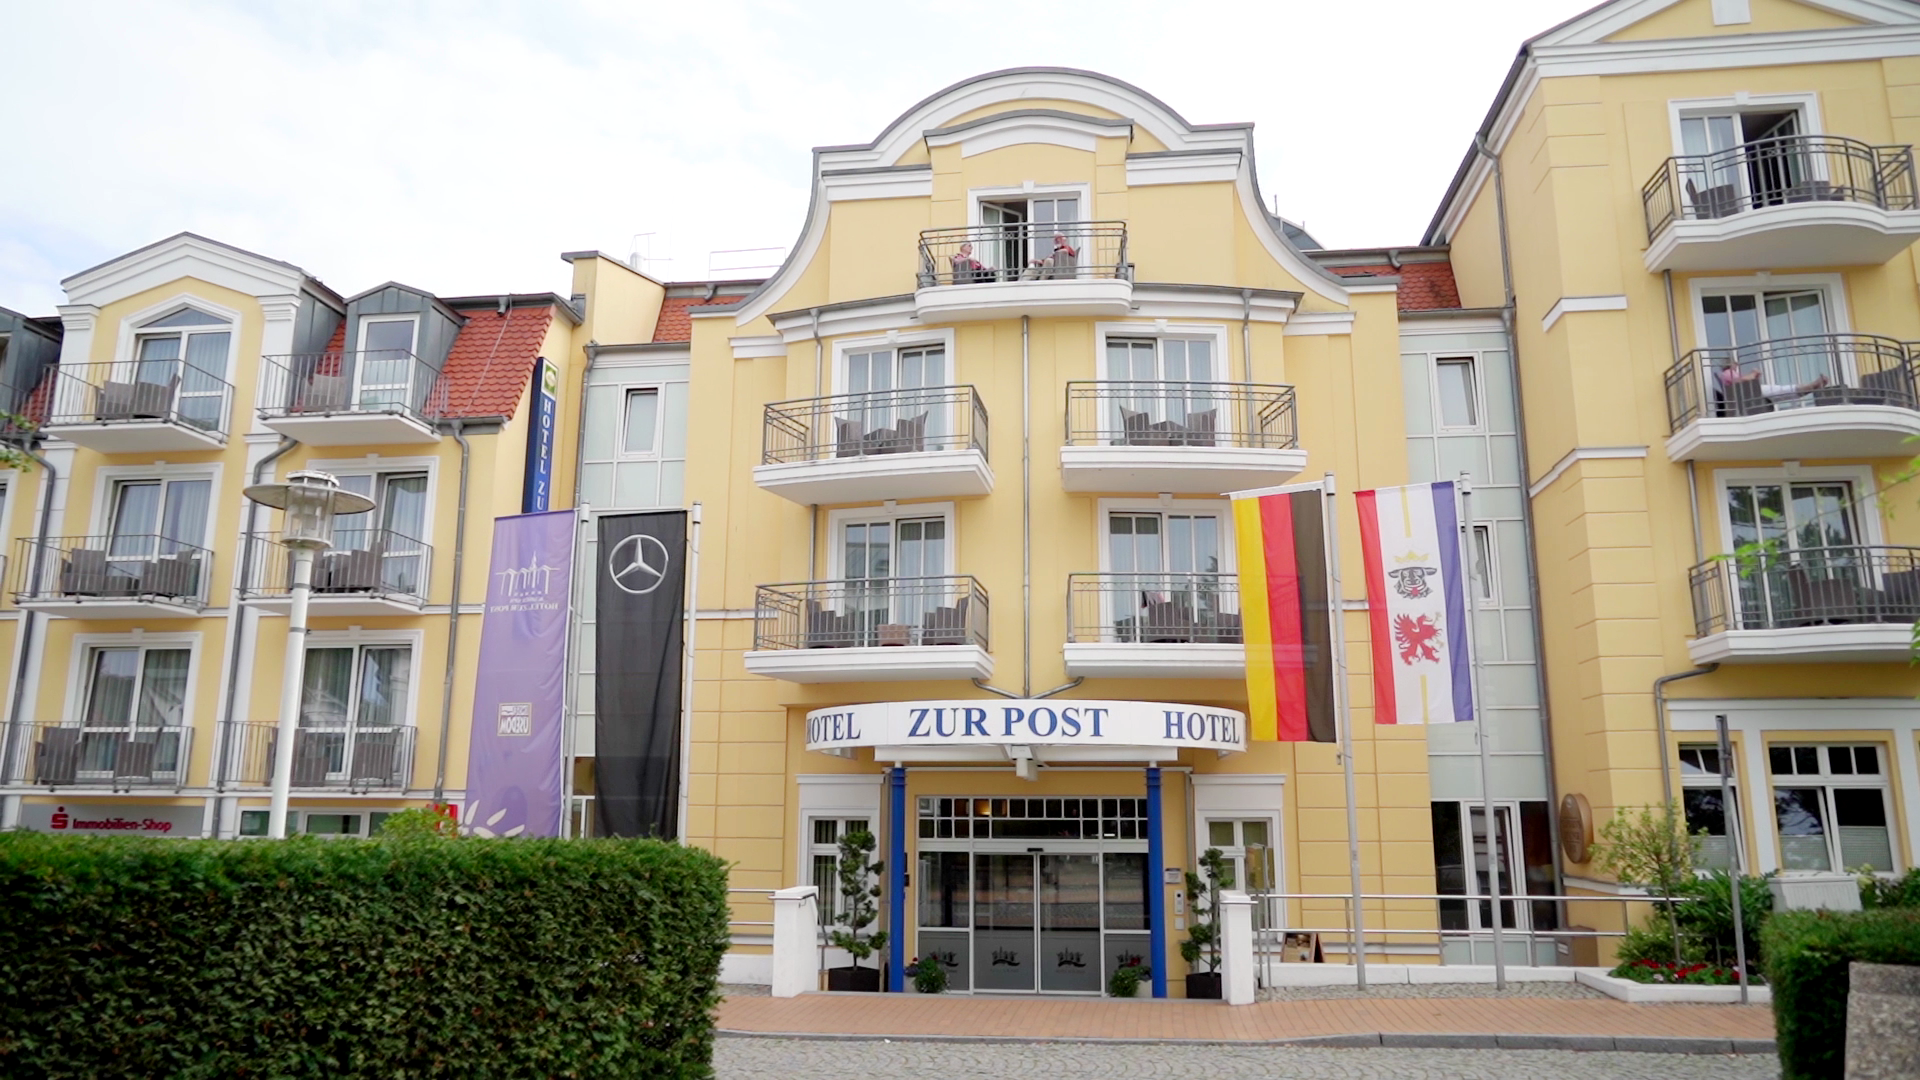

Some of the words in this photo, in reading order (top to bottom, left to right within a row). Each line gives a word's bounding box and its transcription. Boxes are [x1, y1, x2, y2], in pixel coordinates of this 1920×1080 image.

[539, 399, 552, 475] HOTEL
[536, 480, 545, 511] ZU
[907, 707, 991, 737] ZUR
[1001, 707, 1109, 737] POST
[1162, 710, 1240, 744] HOTEL
[72, 818, 172, 833] Immobilien-Shop
